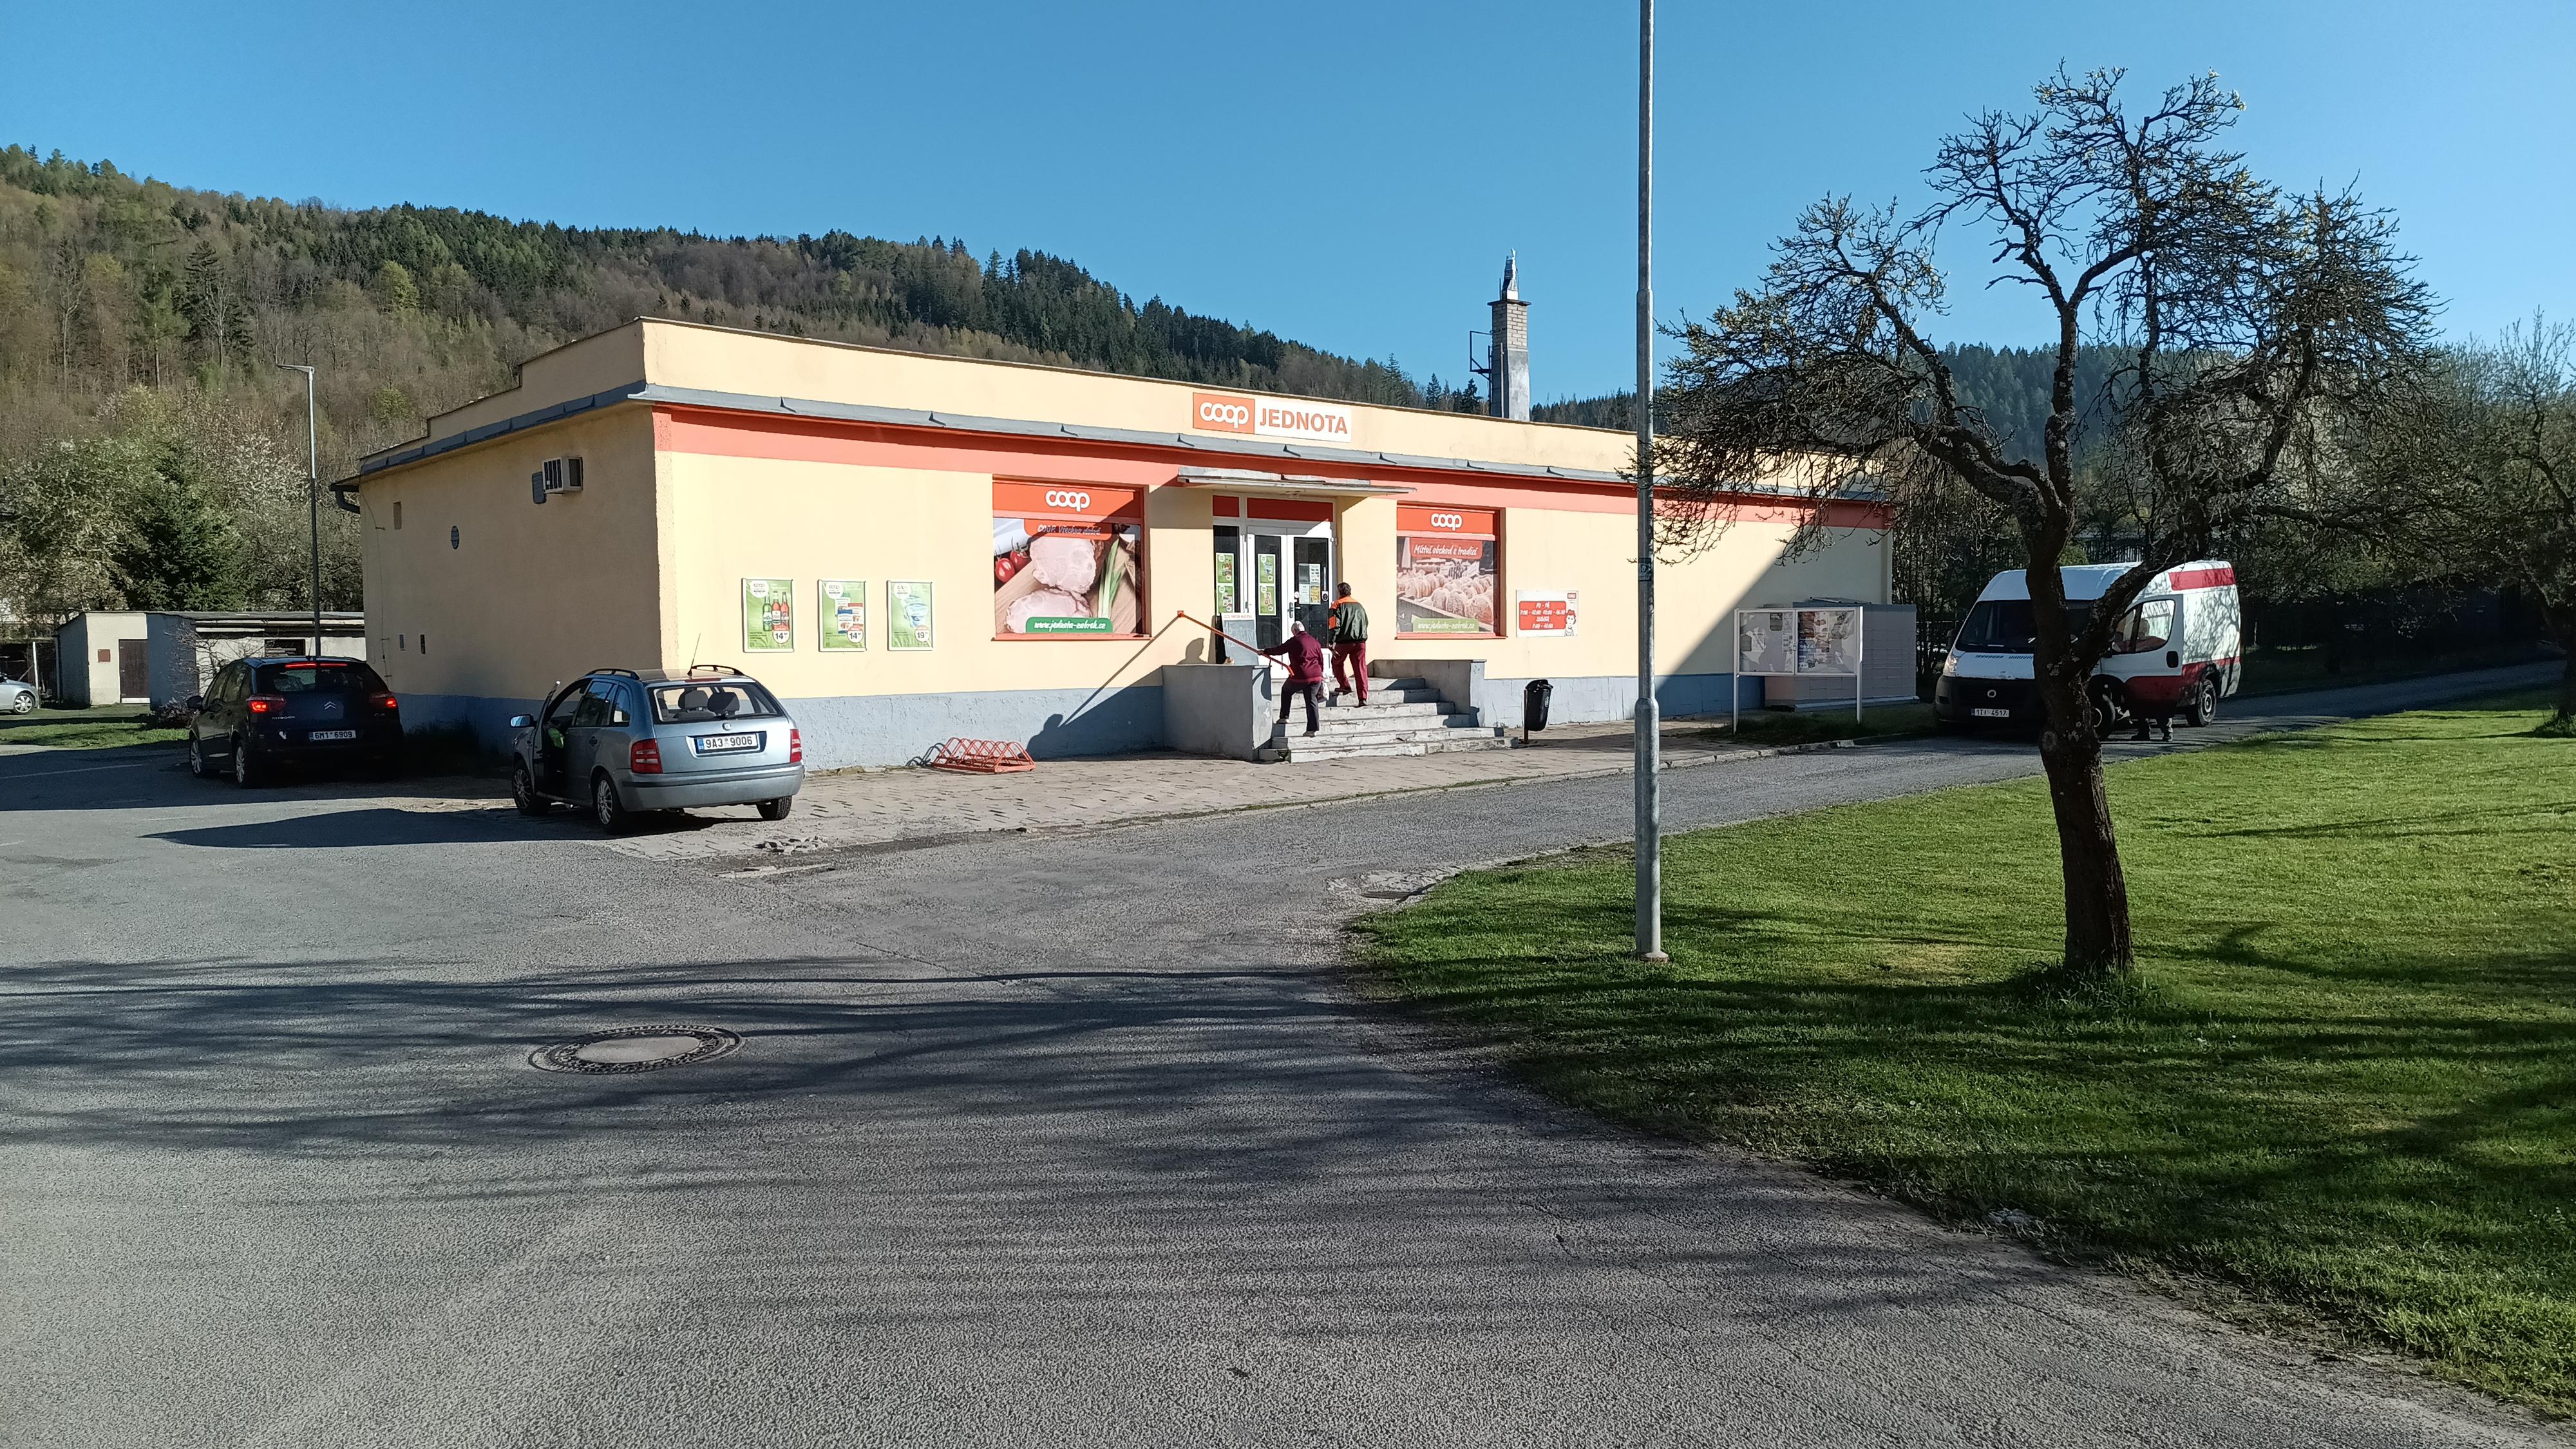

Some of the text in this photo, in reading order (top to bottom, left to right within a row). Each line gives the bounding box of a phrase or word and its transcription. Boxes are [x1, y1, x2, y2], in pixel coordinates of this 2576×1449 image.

[1199, 401, 1348, 434] coop JEDNOTA
[1045, 489, 1091, 512] coop
[1431, 513, 1463, 531] coop
[1433, 544, 1454, 555] obchod
[705, 736, 753, 748] 9A3 9006
